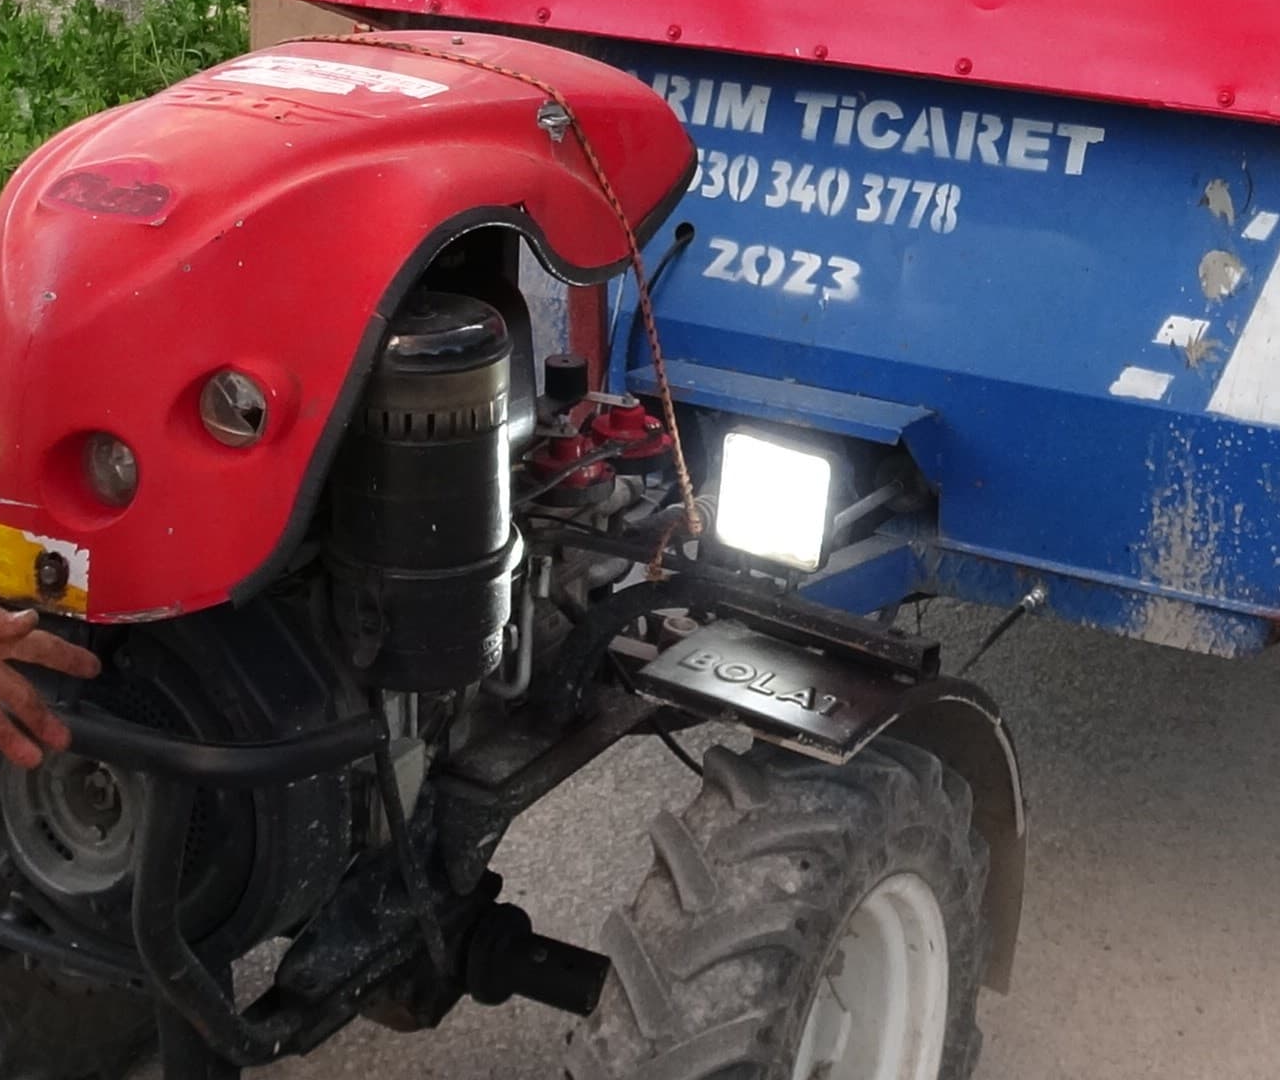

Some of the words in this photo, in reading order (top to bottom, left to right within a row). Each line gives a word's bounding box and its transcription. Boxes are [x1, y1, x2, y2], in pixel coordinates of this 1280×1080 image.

[626, 70, 772, 135] RIM
[764, 158, 852, 218] 340
[855, 172, 962, 235] 3778
[702, 238, 863, 302] 2023
